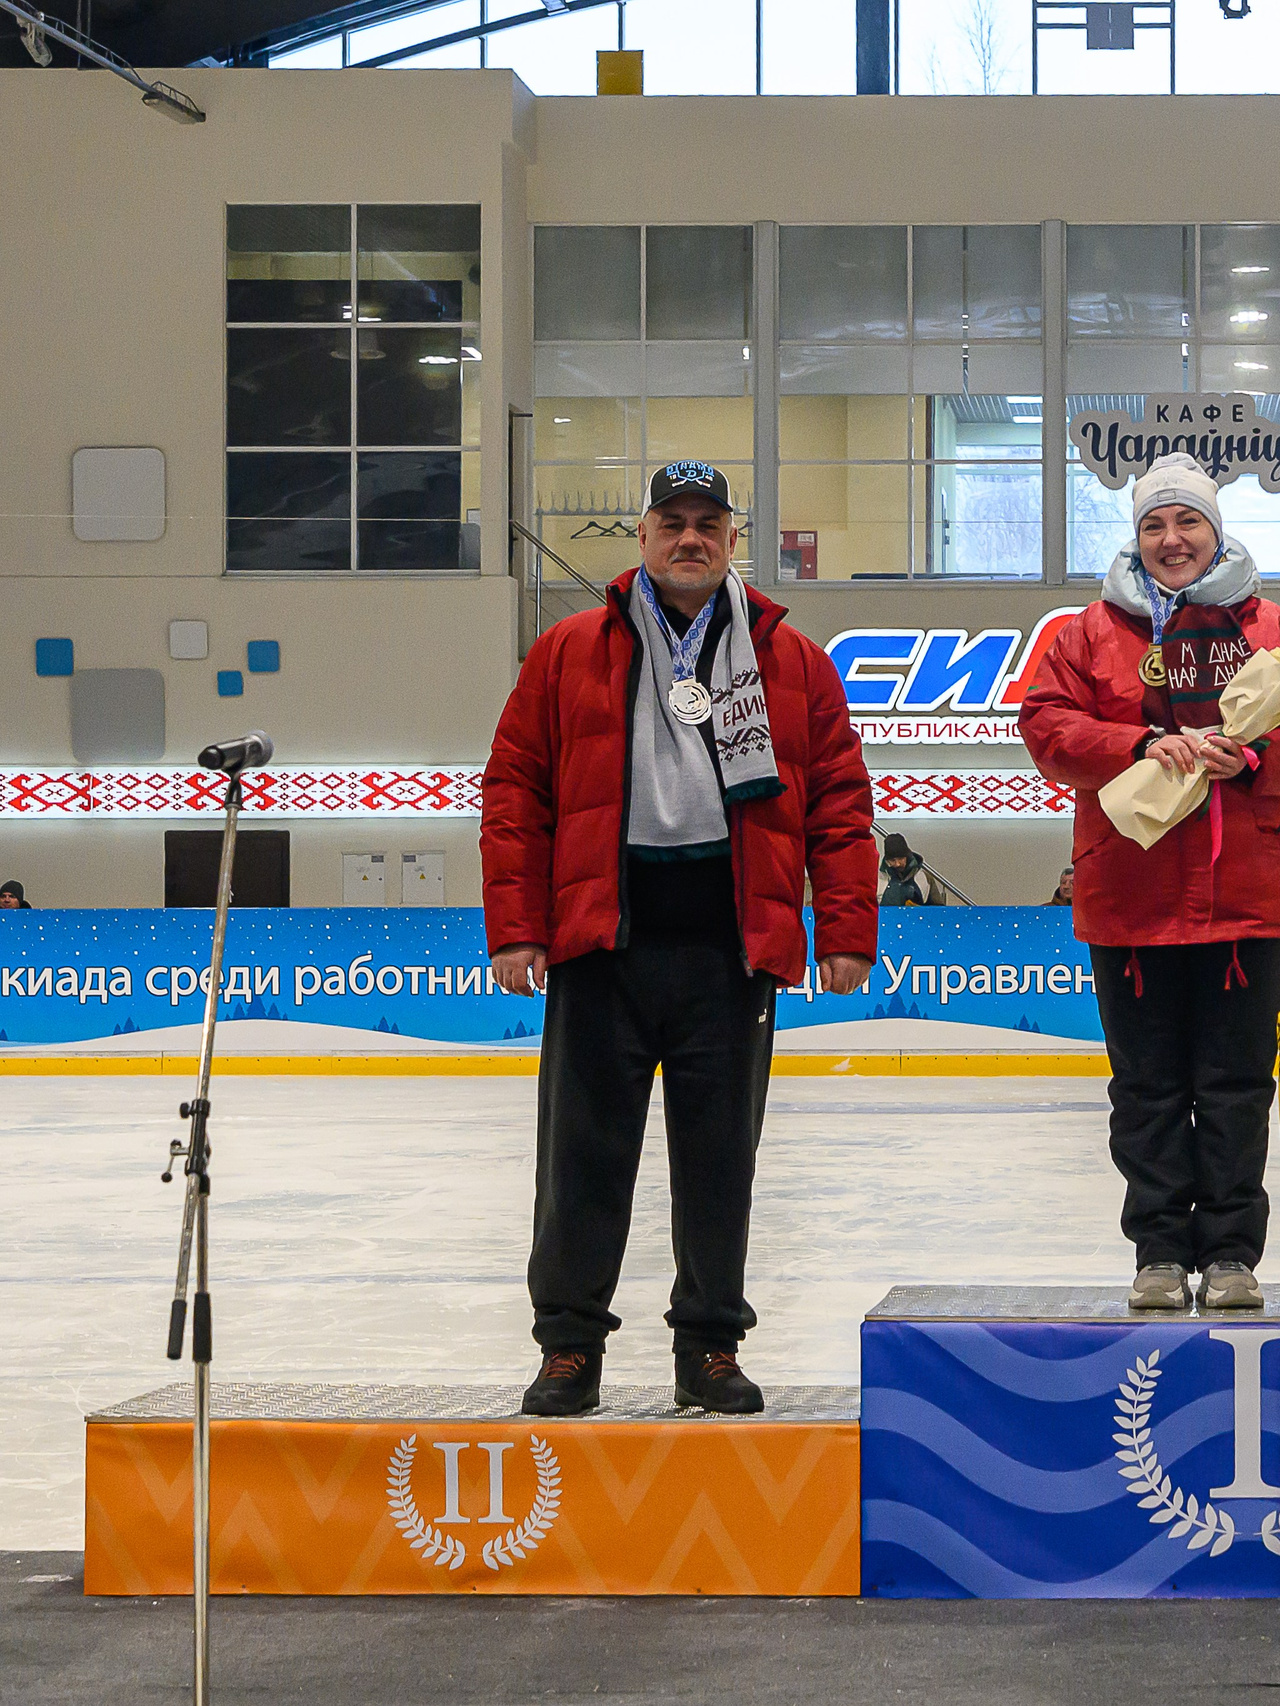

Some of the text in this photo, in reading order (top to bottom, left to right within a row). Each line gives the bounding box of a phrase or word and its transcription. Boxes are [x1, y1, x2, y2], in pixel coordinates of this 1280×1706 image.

[1156, 404, 1244, 423] КАФЕ
[850, 722, 1022, 738] ПУБЛИКАН
[2, 966, 133, 1005] киада
[145, 966, 281, 1006] среди
[433, 1442, 515, 1524] II
